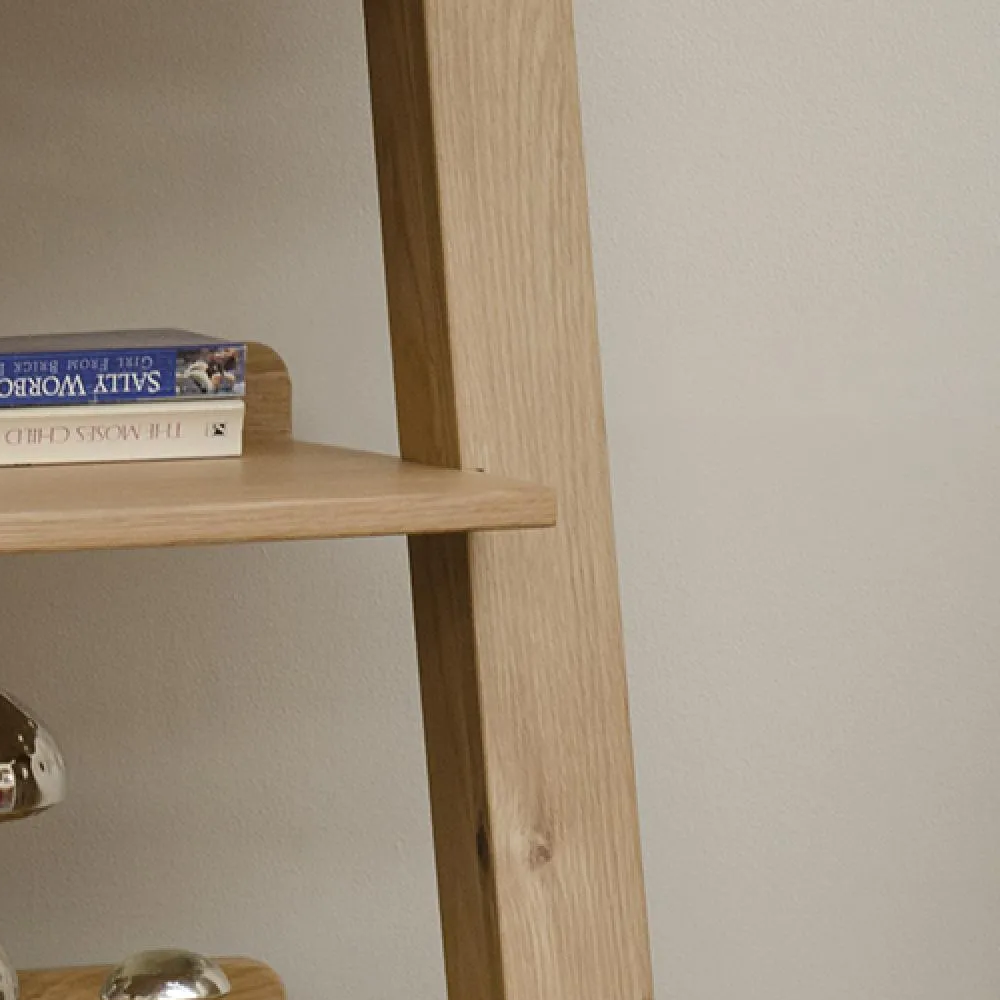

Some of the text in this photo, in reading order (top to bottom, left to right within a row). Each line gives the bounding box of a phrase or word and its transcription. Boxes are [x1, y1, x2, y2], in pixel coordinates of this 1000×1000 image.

[94, 370, 161, 394] SALLY
[5, 422, 181, 445] THE MOSES CHILD
